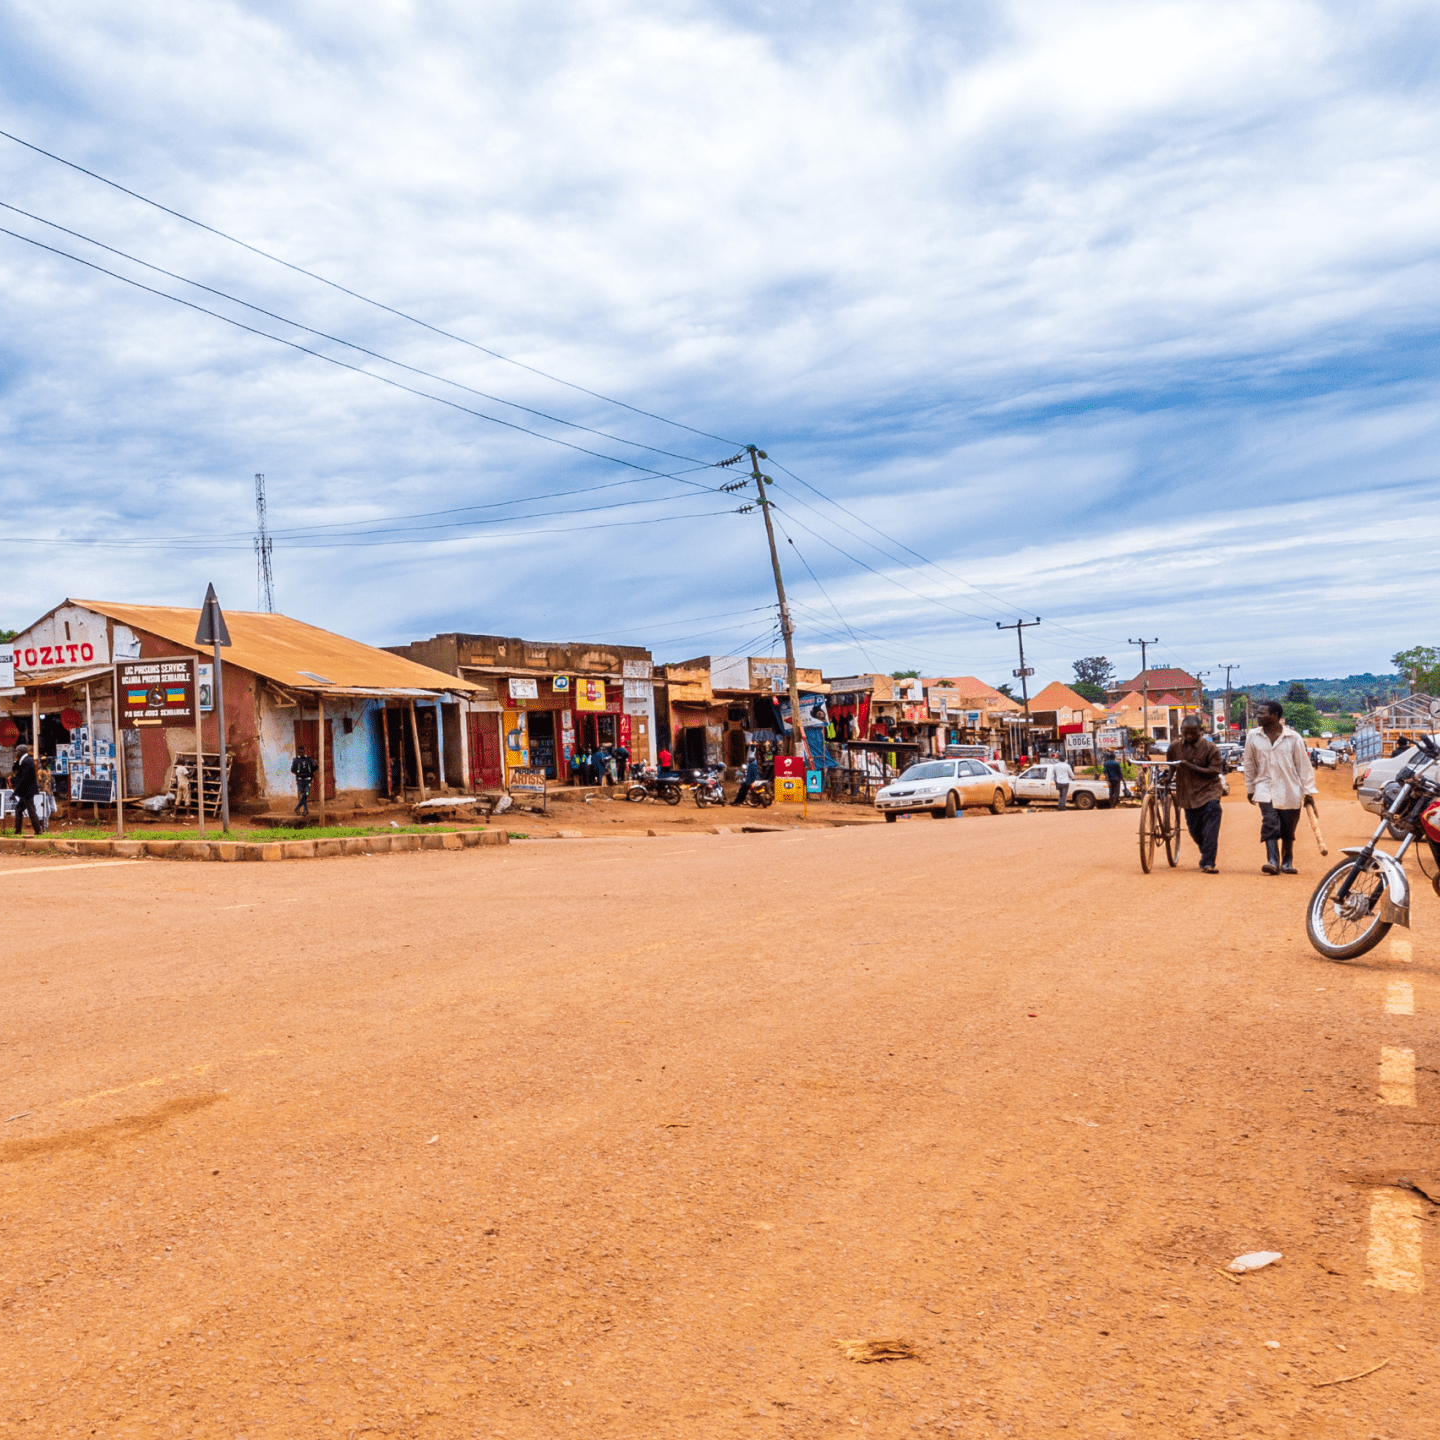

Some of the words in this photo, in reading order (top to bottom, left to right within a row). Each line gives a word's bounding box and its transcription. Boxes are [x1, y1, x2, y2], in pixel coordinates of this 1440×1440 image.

[13, 642, 94, 668] JOZITO
[161, 663, 187, 673] SERVICE
[1067, 738, 1091, 747] LODGE
[510, 773, 546, 786] ARTISTS
